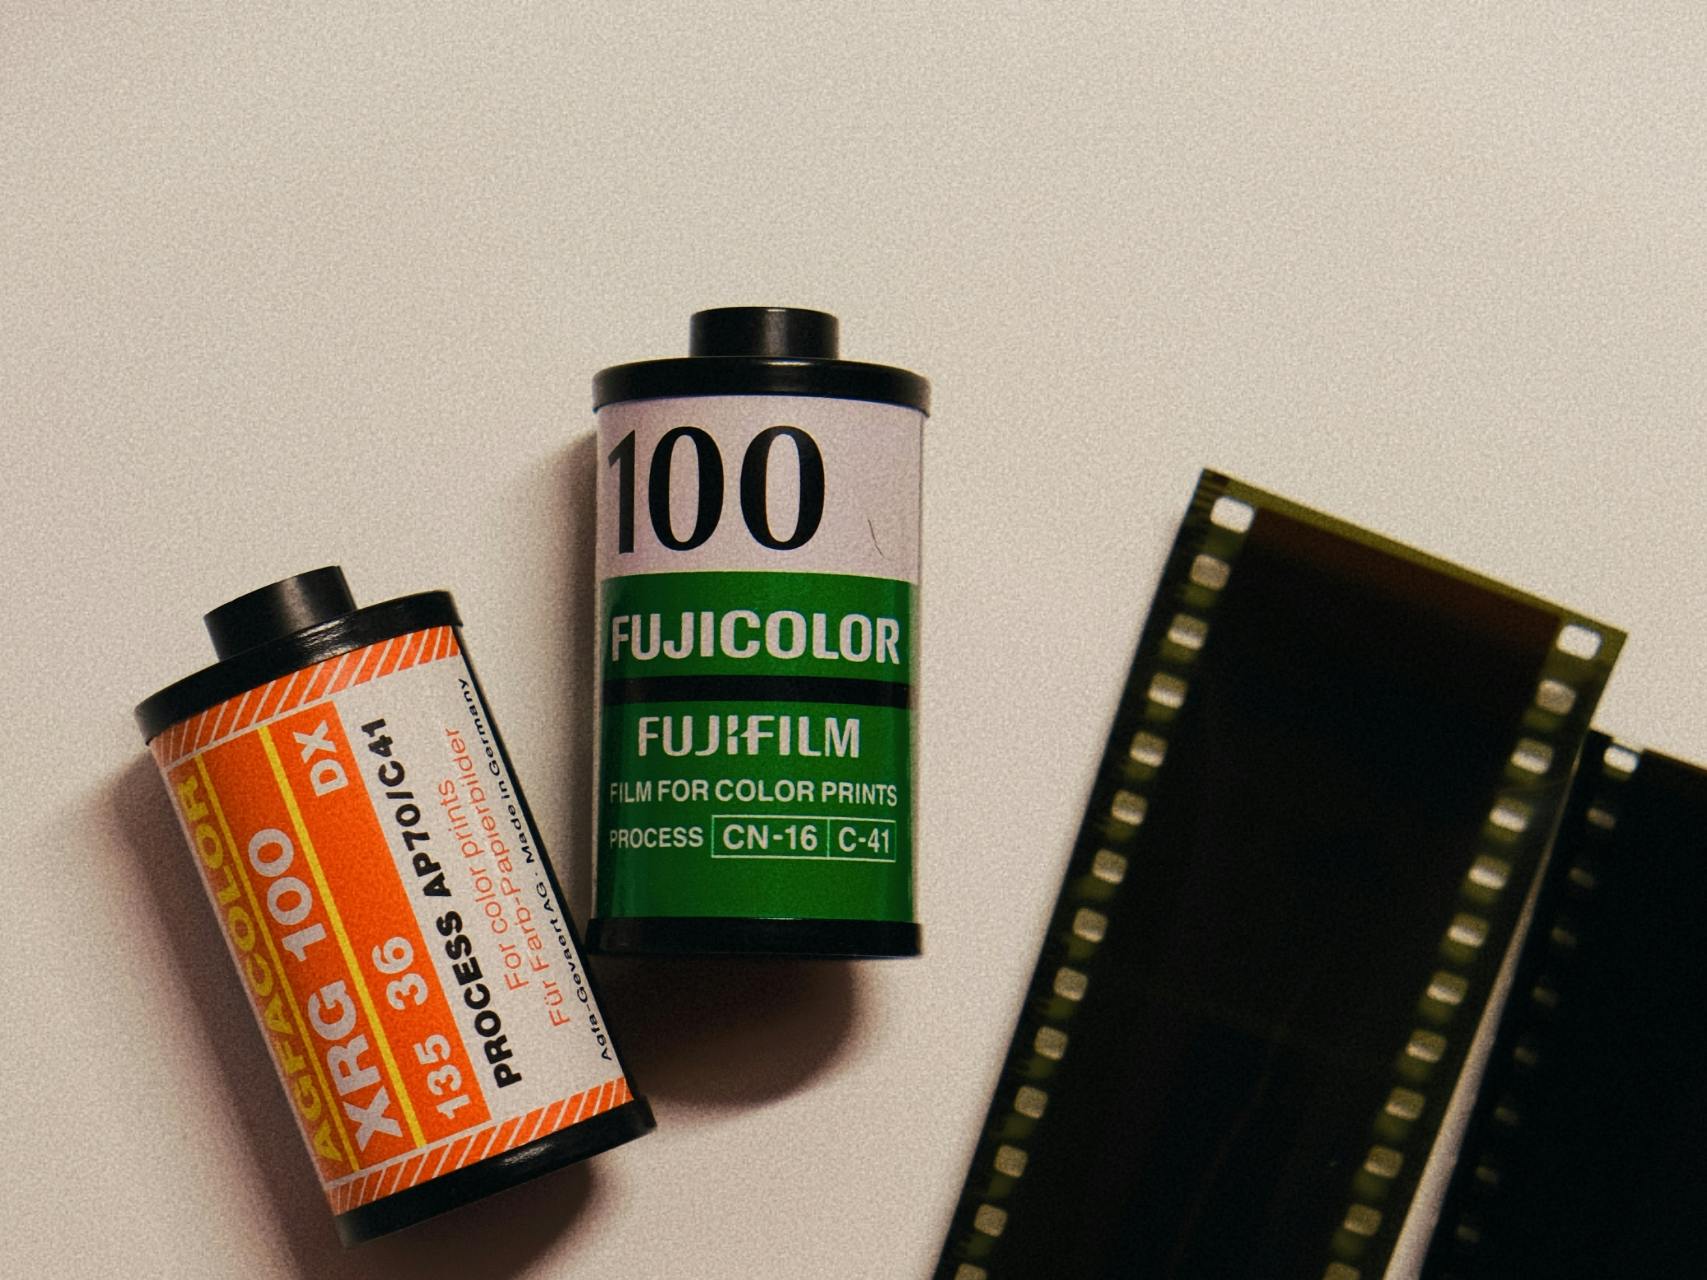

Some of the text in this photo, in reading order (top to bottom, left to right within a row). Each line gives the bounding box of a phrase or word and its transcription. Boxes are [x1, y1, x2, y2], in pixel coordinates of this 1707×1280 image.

[608, 425, 825, 554] 100
[611, 609, 900, 664] FUJICOLOR
[293, 719, 348, 797] DX
[458, 678, 500, 776] Germany
[638, 715, 860, 758] FUJIFILM
[498, 780, 510, 799] in
[507, 804, 535, 864] Made
[610, 779, 898, 807] FILM FOR COLOR PRINTS
[610, 824, 890, 853] PROCESS CN-16 C-41
[361, 718, 522, 1089] PROCESS AP70/C41
[438, 779, 529, 991] For color prints
[445, 728, 570, 1027] Für Farb-Papierbilder
[178, 776, 343, 1162] AGFACOLOR
[248, 828, 403, 1152] XRG 100
[550, 918, 612, 1061] Agfa-Gevaert
[371, 936, 471, 1119] 135 36
